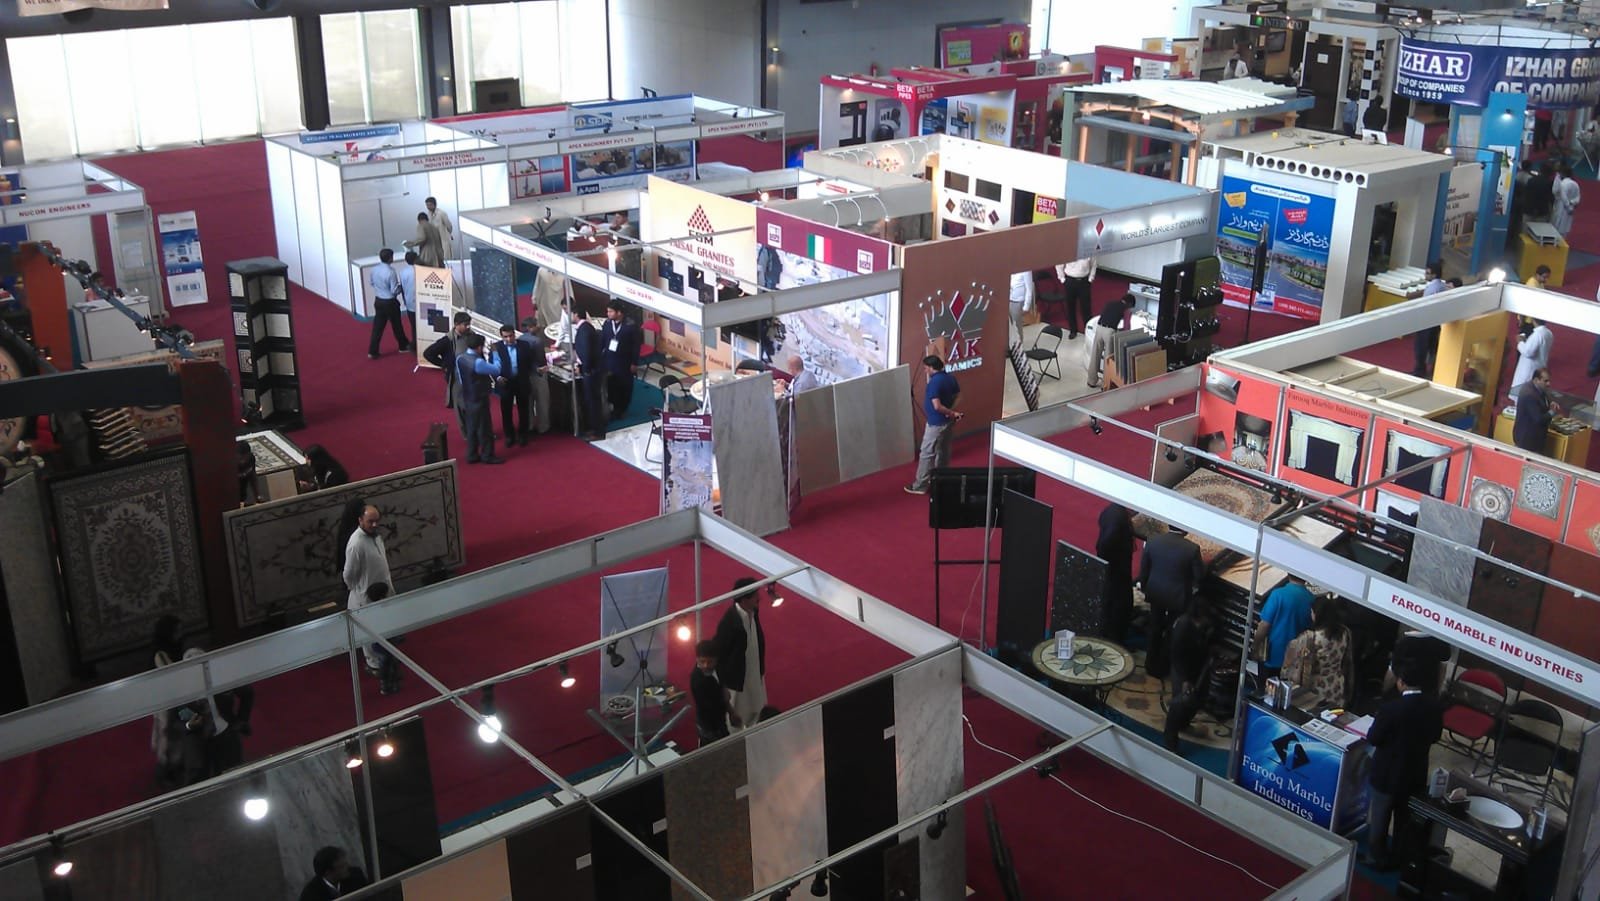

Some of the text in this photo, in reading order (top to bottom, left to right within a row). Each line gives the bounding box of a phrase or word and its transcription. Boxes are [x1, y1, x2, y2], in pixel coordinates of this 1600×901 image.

[1505, 56, 1567, 78] IZHAR
[896, 83, 914, 94] BETA
[917, 85, 935, 94] BETA
[1402, 87, 1443, 100] Since 1959
[1409, 79, 1418, 88] OF
[1418, 81, 1466, 94] COMPANIES
[584, 138, 612, 148] MACHINERY
[424, 160, 453, 168] INDUSTRY
[460, 156, 485, 164] TRADERS
[425, 155, 453, 163] PAKISTAN
[19, 203, 91, 217] NUCON ENGINEERS
[1037, 198, 1057, 208] BETA
[1120, 217, 1208, 240] WORLD'S LARGEST COMPANY
[697, 246, 735, 267] GRANITES
[944, 357, 983, 374] RAMICS
[1391, 594, 1584, 684] FAROOQ MARBLE INDUSTRIES
[1242, 754, 1332, 812] Farooq Marble
[1253, 780, 1314, 821] Industries
